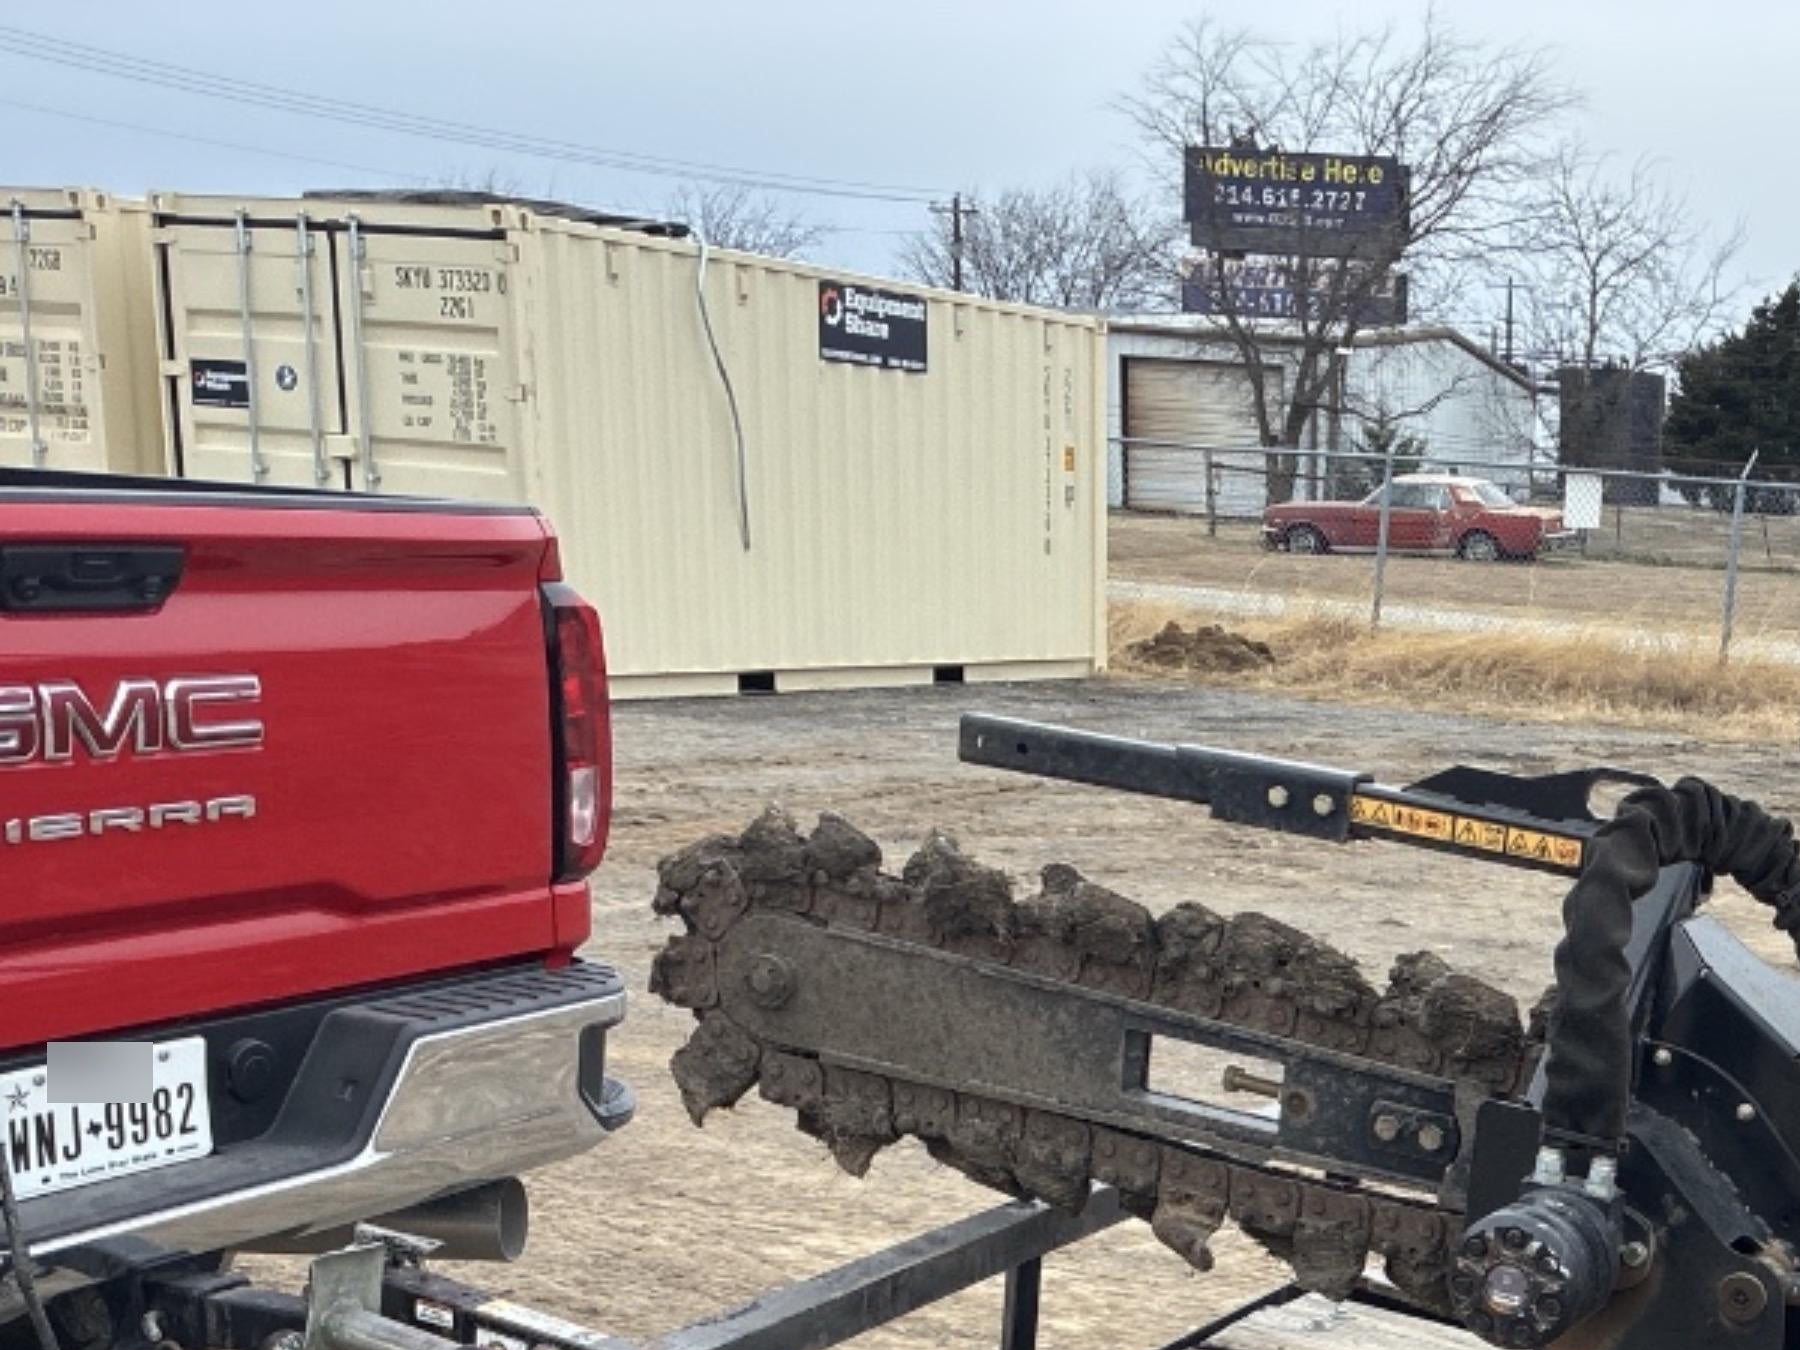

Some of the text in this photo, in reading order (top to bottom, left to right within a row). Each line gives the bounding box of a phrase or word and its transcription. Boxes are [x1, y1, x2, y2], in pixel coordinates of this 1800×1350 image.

[5, 794, 256, 844] IERRA
[8, 1082, 198, 1174] WNJ 9982
